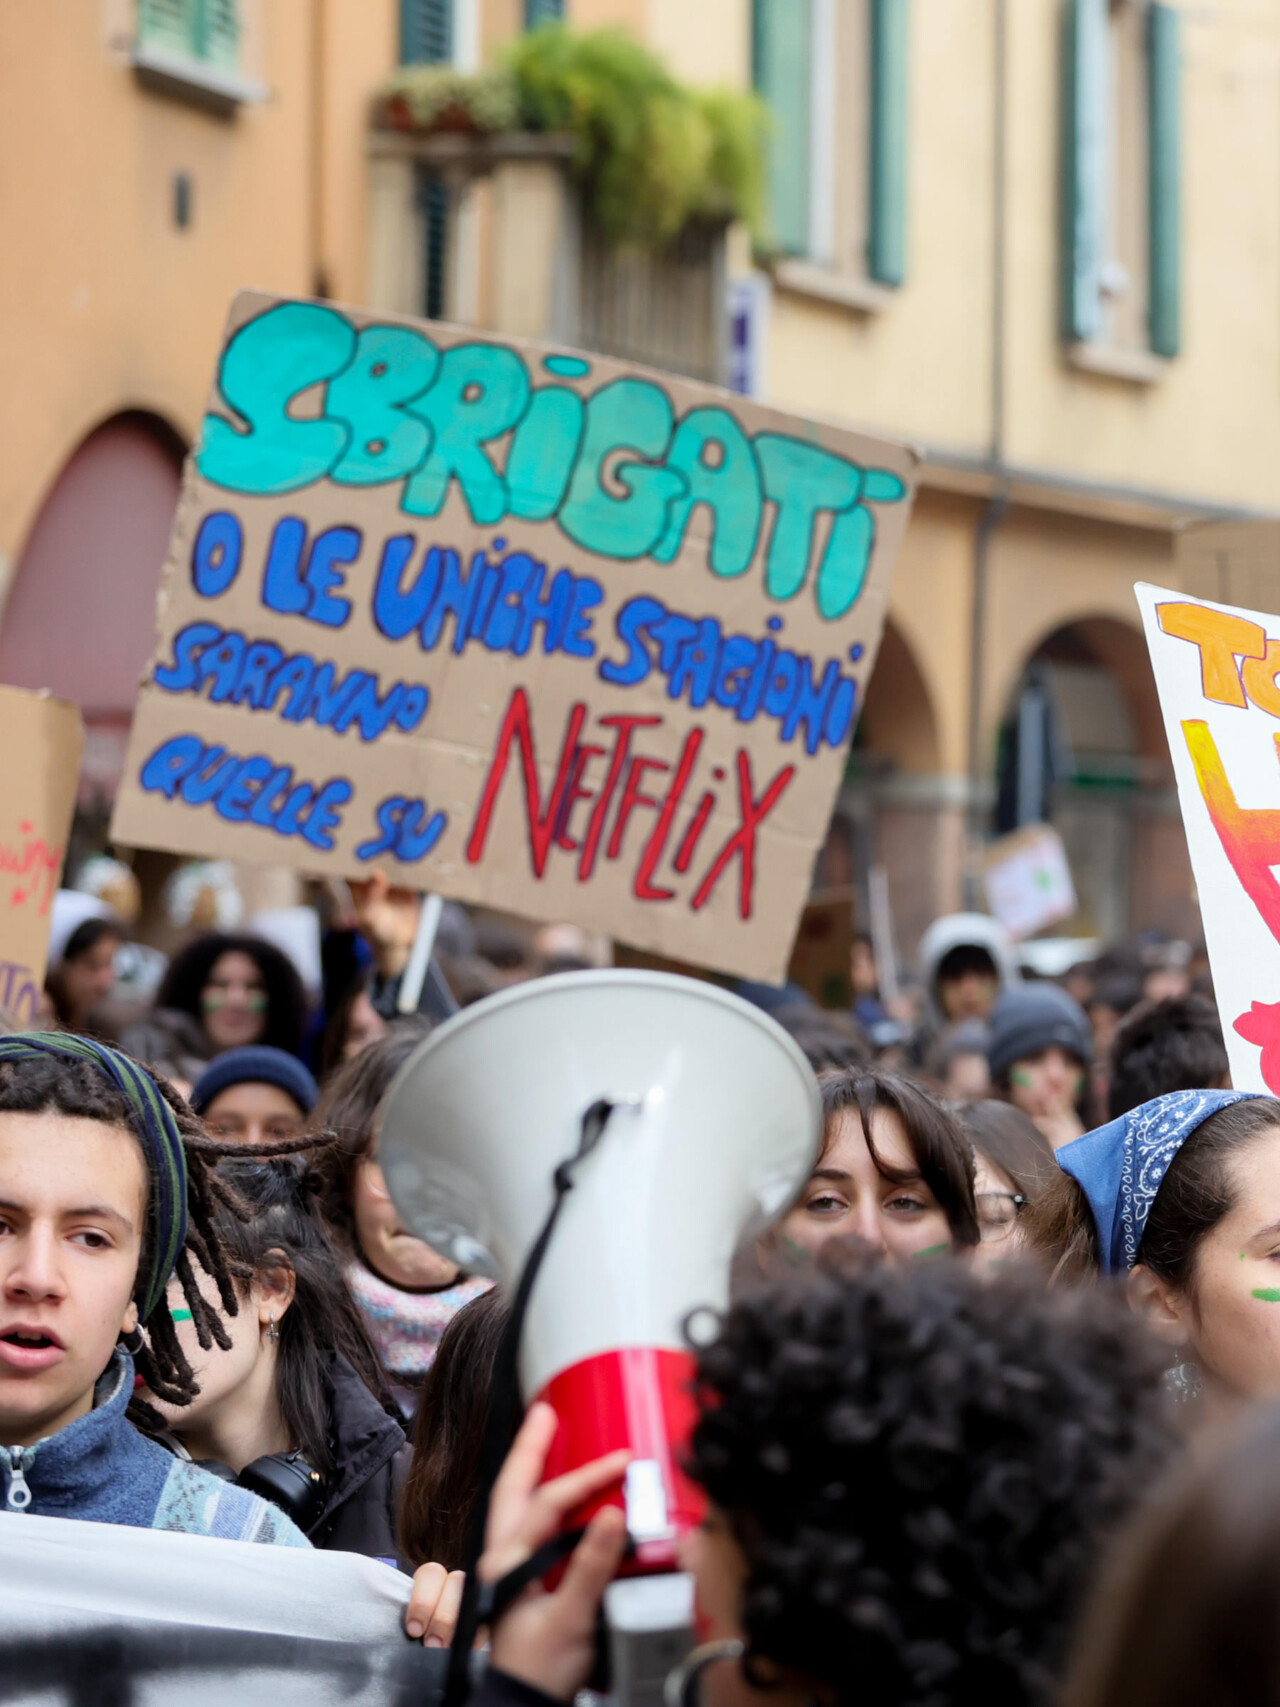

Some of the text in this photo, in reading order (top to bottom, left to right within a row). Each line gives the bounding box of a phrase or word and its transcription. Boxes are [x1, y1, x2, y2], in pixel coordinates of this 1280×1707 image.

[189, 510, 243, 598] O
[261, 515, 362, 628] LE
[153, 621, 430, 742] SARANNO
[140, 733, 448, 863] QUELLE SU
